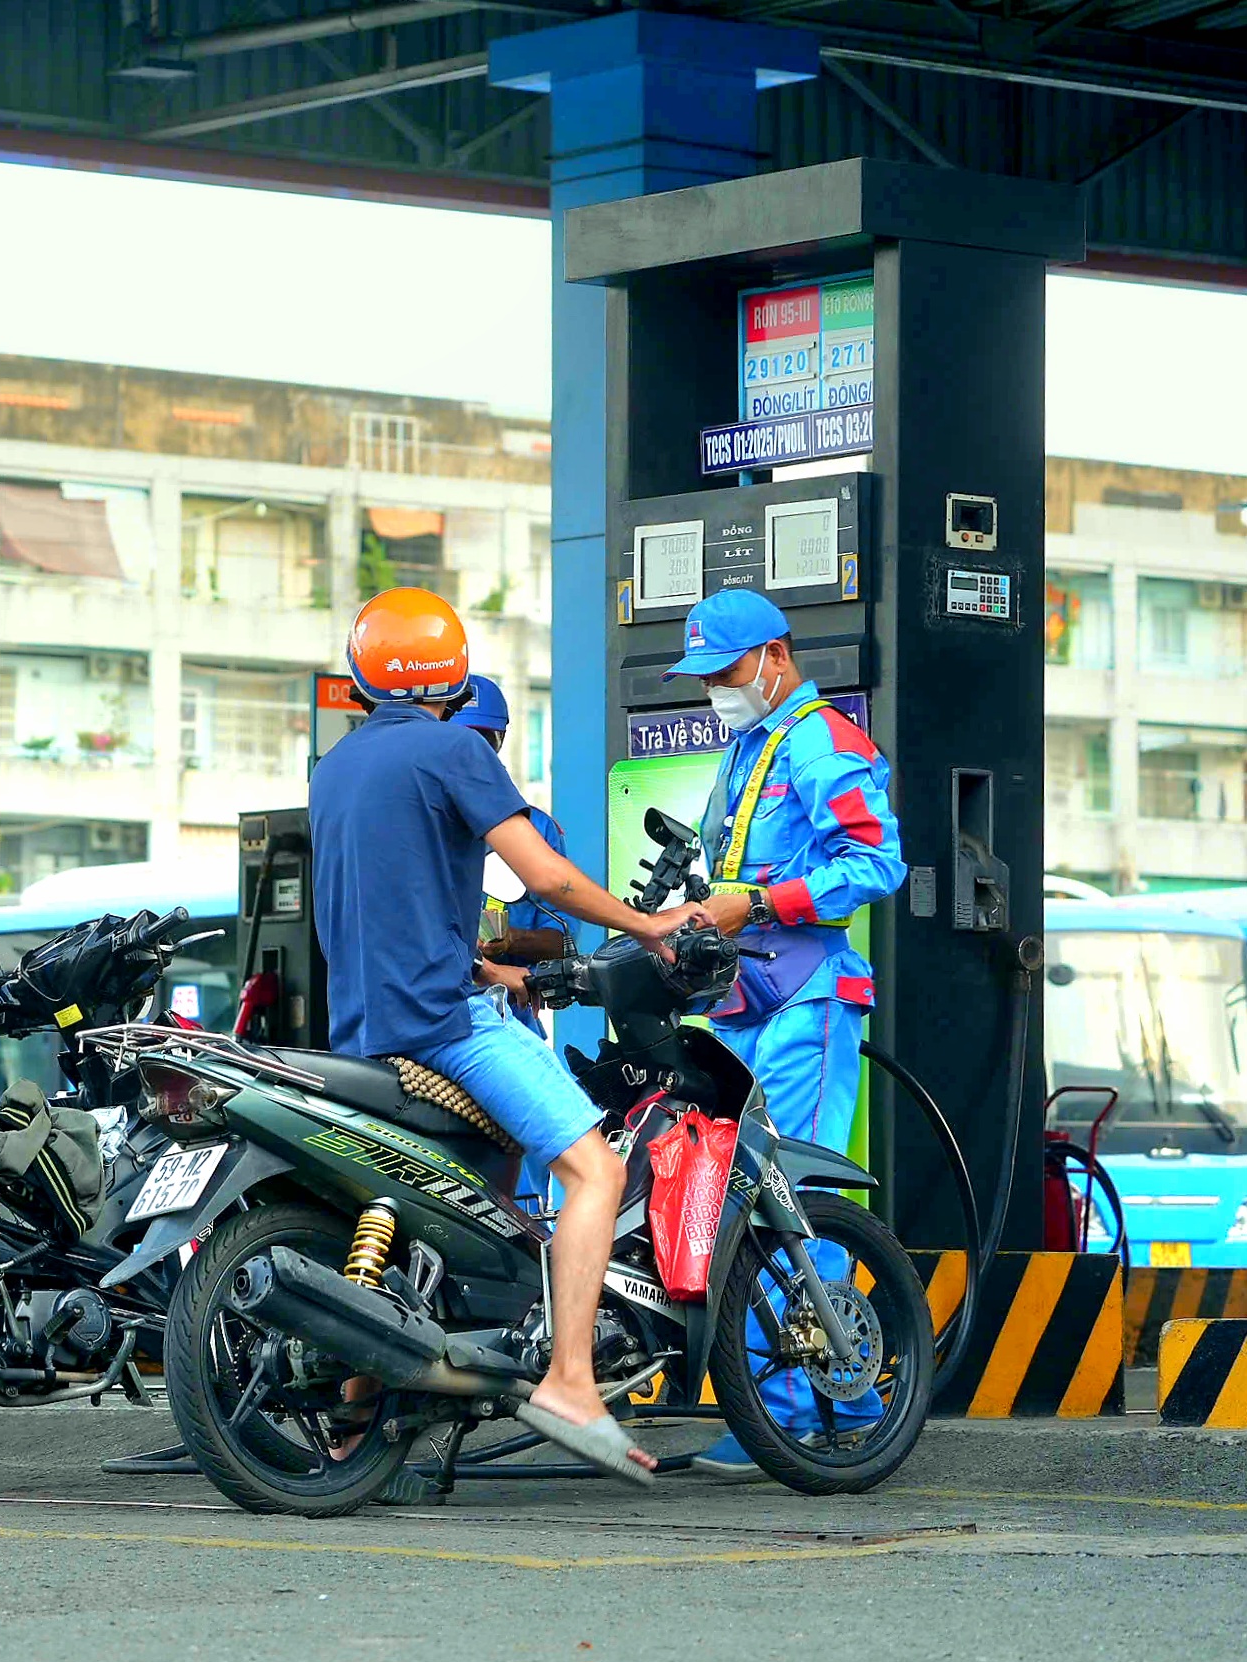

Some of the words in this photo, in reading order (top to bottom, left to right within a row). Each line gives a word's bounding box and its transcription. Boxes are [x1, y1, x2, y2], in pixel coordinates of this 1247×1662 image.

[754, 304, 778, 330] RON
[781, 299, 810, 325] 95-III
[747, 351, 806, 380] 29120
[832, 340, 873, 368] 271
[753, 385, 815, 417] ĐỒNG/LÍT
[706, 431, 732, 466] TCCS
[733, 421, 806, 462] 01:2025/PVOIL
[816, 414, 843, 449] TCCS
[722, 524, 753, 536] ĐỒNG
[724, 547, 754, 558] LÍT
[844, 559, 857, 595] 2
[619, 587, 630, 620] 1
[406, 658, 455, 671] Ahamove
[638, 724, 664, 750] Trả
[667, 717, 688, 748] Về
[692, 715, 713, 746] Số
[624, 1279, 672, 1308] YAMAHA
